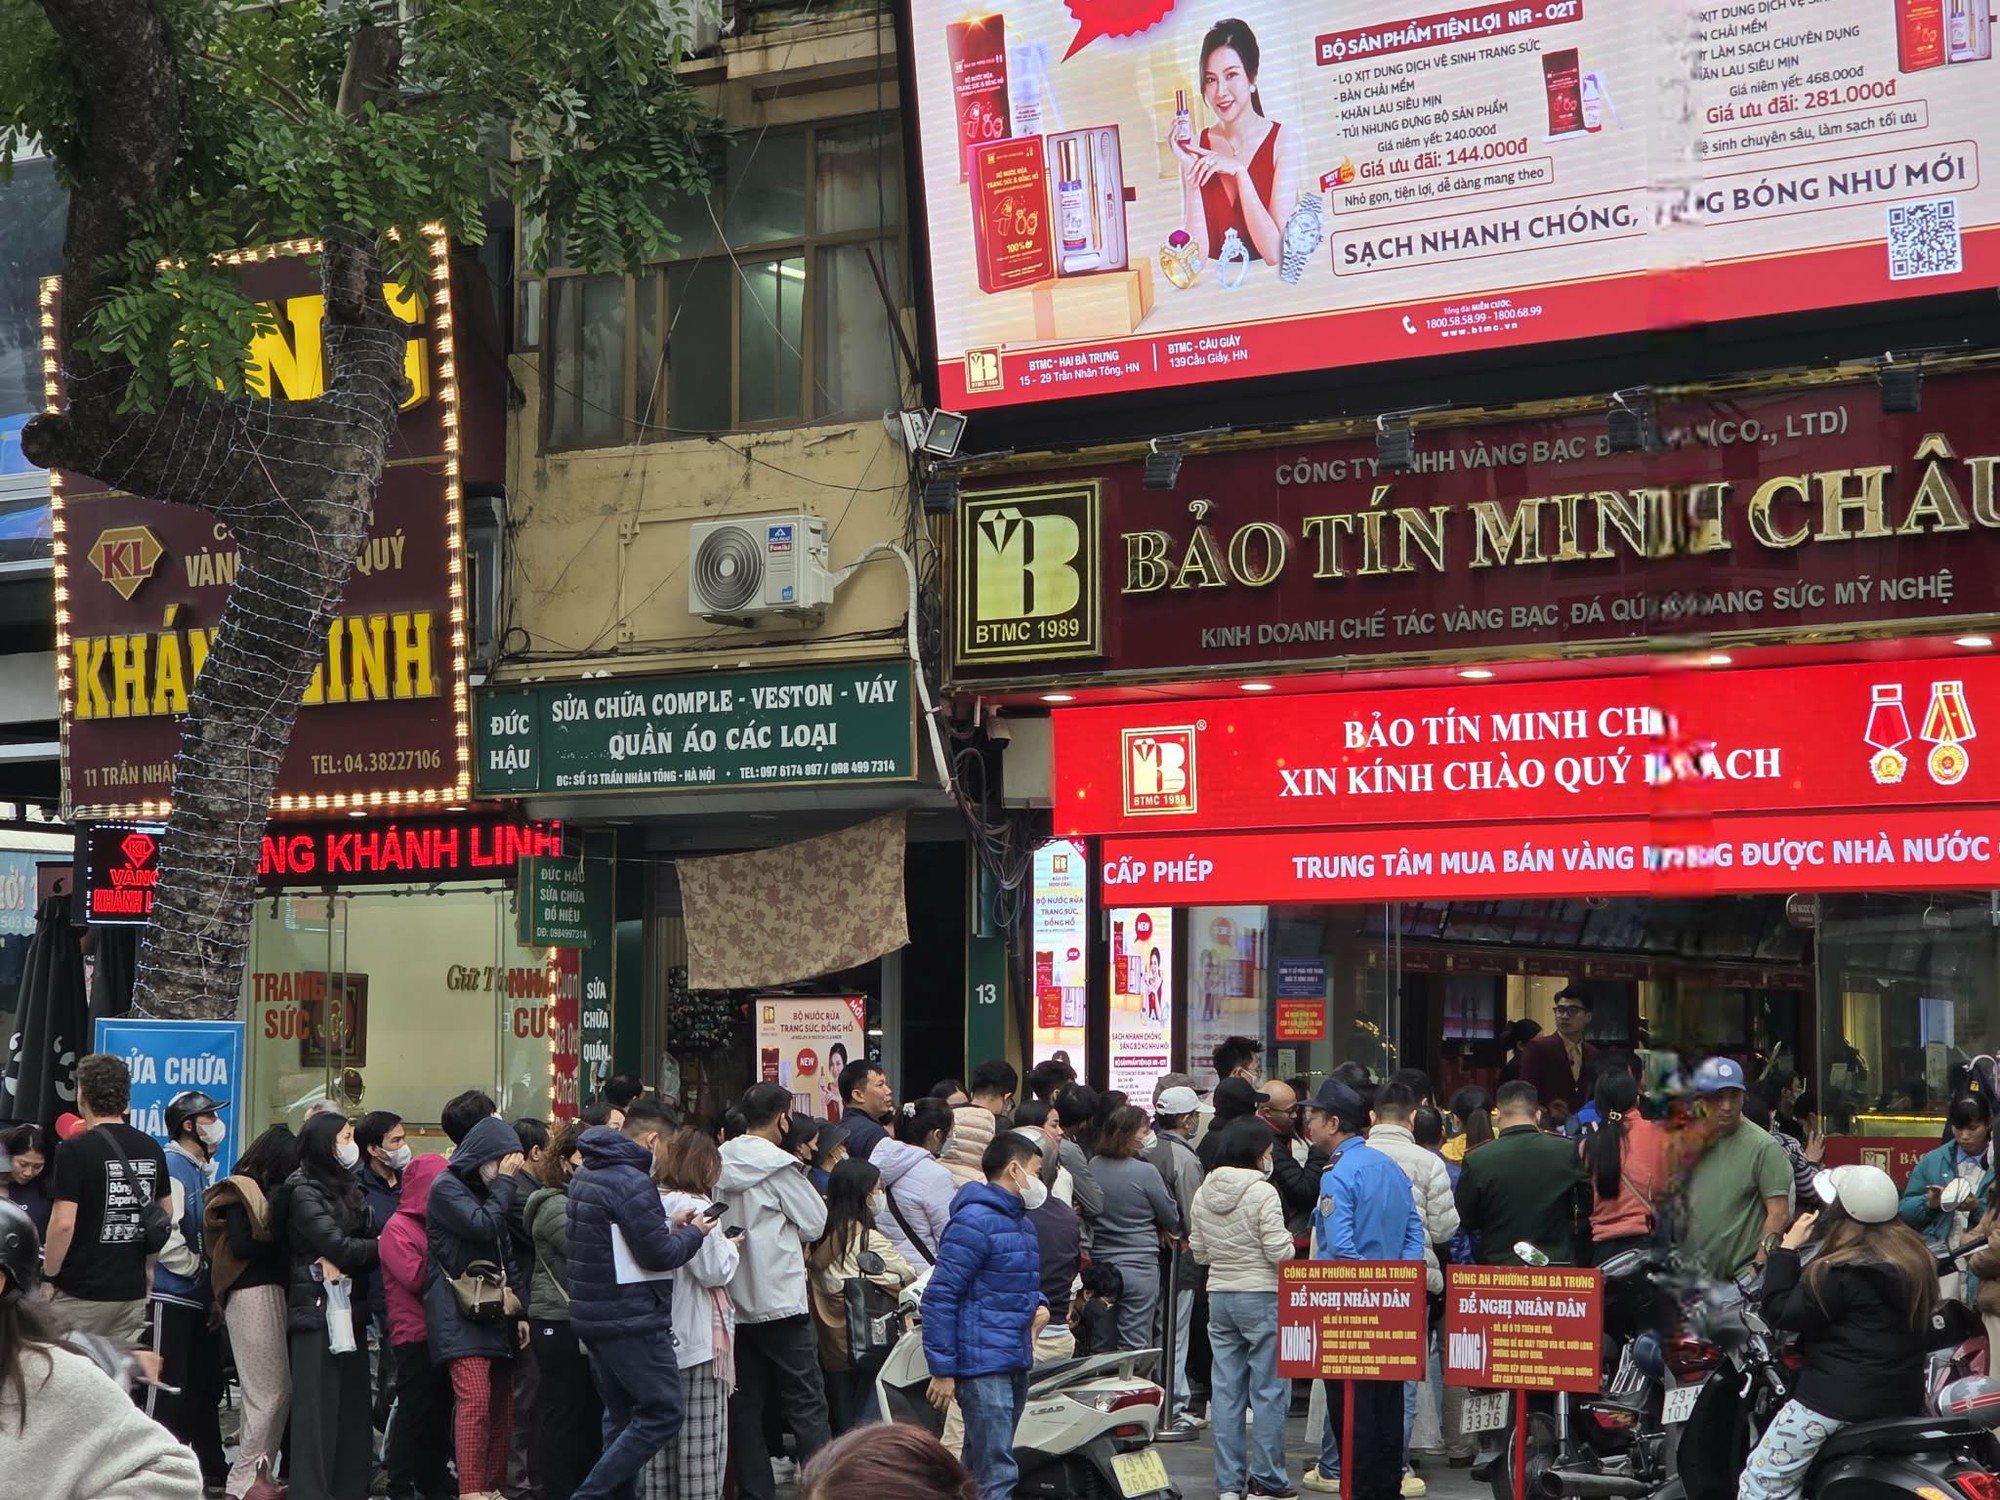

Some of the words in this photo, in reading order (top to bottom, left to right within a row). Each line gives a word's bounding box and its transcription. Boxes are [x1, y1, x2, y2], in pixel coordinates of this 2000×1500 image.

[1322, 42, 1345, 63] BỘ
[1349, 33, 1381, 53] SẢN
[1384, 20, 1431, 47] PHẨM
[1436, 18, 1470, 43] TIỆN
[1473, 13, 1501, 34] LỢI
[1508, 8, 1532, 26] NR
[1355, 70, 1371, 83] XỊT
[1374, 65, 1403, 79] DUNG
[1406, 59, 1431, 75] DỊCH
[1434, 54, 1449, 69] VỆ
[1450, 51, 1476, 66] SINH
[1479, 46, 1516, 62] TRANG
[1519, 39, 1541, 56] SỨC
[1341, 108, 1371, 121] KHĂN
[1373, 104, 1397, 117] LAU
[1397, 97, 1420, 112] SIÊU
[1422, 94, 1442, 108] MỊN
[1706, 105, 1734, 124] Giá
[1739, 102, 1763, 119] ưu
[1768, 97, 1799, 115] đãi:
[1804, 78, 1897, 109] 281.000đ
[1360, 159, 1385, 179] Giá
[1390, 158, 1411, 174] ưu
[1414, 153, 1442, 171] đãi:
[1446, 137, 1528, 167] 144.000đ
[1344, 193, 1367, 207] Nhỏ
[1369, 190, 1393, 208] gọn,
[1395, 184, 1416, 200] tiện
[1418, 181, 1435, 197] lợi,
[1437, 176, 1451, 193] dễ
[1453, 174, 1482, 192] dàng
[1484, 172, 1515, 188] mang
[1518, 167, 1545, 181] theo
[1733, 178, 1820, 211] BÓNG
[1828, 163, 1898, 197] NHƯ
[1905, 152, 1966, 186] MỚI
[1344, 234, 1413, 268] SẠCH
[1421, 218, 1521, 255] NHANH
[1528, 204, 1639, 239] CHÓNG,
[1426, 313, 1486, 329] 1800.58.58.99
[1494, 305, 1542, 321] 1800.68.99
[1276, 455, 1347, 485] CÔNG
[1461, 440, 1527, 469] VÀNG
[1533, 435, 1585, 466] BẠC
[1709, 419, 1777, 448] (CO.,
[1786, 406, 1848, 438] LTD)
[356, 530, 405, 576] QUÝ
[1121, 498, 1288, 595] BẢO
[1303, 485, 1453, 579] TÍN
[102, 539, 151, 580] KL
[1201, 624, 1251, 649] KINH
[1257, 620, 1334, 646] DOANH
[1339, 611, 1385, 642] CHẾ
[1392, 605, 1435, 638] TÁC
[1443, 603, 1504, 633] VÀNG
[1510, 602, 1559, 632] BẠC
[1570, 594, 1605, 626] ĐÁ
[1773, 577, 1825, 610] SỨC
[1834, 574, 1872, 605] MỸ
[1880, 568, 1954, 605] NGHỆ
[975, 623, 1031, 644] BTMC
[1037, 618, 1080, 640] 1989
[552, 690, 589, 723] SỬA
[595, 689, 647, 720] CHỮA
[651, 688, 733, 717] COMPLE
[751, 682, 833, 710] VESTON
[855, 674, 898, 704] VÁY
[490, 710, 530, 736] ĐỨC
[608, 722, 673, 761] QUẦN
[682, 720, 717, 753] ÁO
[725, 720, 772, 751] CÁC
[780, 721, 837, 753] LOẠI
[1344, 710, 1416, 750] BẢO
[1422, 707, 1481, 746] TÍN
[1491, 706, 1587, 743] MINH
[84, 769, 97, 786] 11
[102, 759, 139, 787] TRẦN
[311, 754, 342, 775] TEL:
[344, 749, 441, 773] 04.38227106
[490, 745, 530, 775] HẬU
[573, 770, 586, 785] SỐ
[587, 774, 598, 785] 13
[624, 769, 651, 784] NHÂN
[653, 768, 676, 782] TÔNG
[684, 767, 697, 781] HÀ
[699, 766, 715, 783] NỘI
[740, 767, 759, 779] TEL:
[760, 766, 777, 778] 097
[780, 765, 802, 777] 6174
[804, 763, 822, 775] 897
[831, 762, 849, 775] 098
[851, 761, 869, 773] 499
[871, 759, 895, 772] 7314
[1279, 767, 1337, 798] XIN
[1347, 757, 1434, 794] KÍNH
[1443, 752, 1546, 791] CHÀO
[1555, 746, 1632, 793] QUÝ
[327, 824, 459, 873] KHÁNH
[470, 820, 560, 867] LINH
[1104, 855, 1147, 886] CẤP
[1153, 853, 1213, 883] PHÉP
[1293, 853, 1375, 879] TRUNG
[1381, 848, 1435, 877] TÂM
[1441, 850, 1495, 875] MUA
[1503, 841, 1554, 873] BÁN
[1562, 840, 1633, 871] VÀNG
[1741, 840, 1824, 873] ĐƯỢC
[1833, 832, 1895, 864] NHÀ
[1903, 829, 1990, 863] NƯỚC
[541, 867, 562, 882] ĐỨC
[540, 884, 559, 903] SỬA
[561, 886, 585, 904] CHỮA
[550, 926, 587, 940] 0984997314
[559, 908, 580, 924] HIỆU
[252, 972, 326, 1003] TRANG
[587, 976, 607, 999] SỬA
[975, 983, 997, 1004] 13
[265, 1003, 310, 1040] SỨC
[583, 1010, 609, 1029] CHỮA
[165, 1052, 228, 1085] CHỮA
[800, 1057, 815, 1067] NEW
[1310, 1292, 1341, 1311] NGHỊ
[1344, 1288, 1380, 1307] NHÂN
[1382, 1288, 1411, 1307] DÂN
[1479, 1298, 1512, 1319] NGHỊ
[1515, 1297, 1554, 1317] NHÂN
[1556, 1297, 1586, 1318] DÂN
[1281, 1321, 1311, 1362] KHÔNG
[1449, 1327, 1480, 1370] KHÔNG
[1467, 1394, 1501, 1411] 29-N2
[1466, 1411, 1501, 1432] 3336
